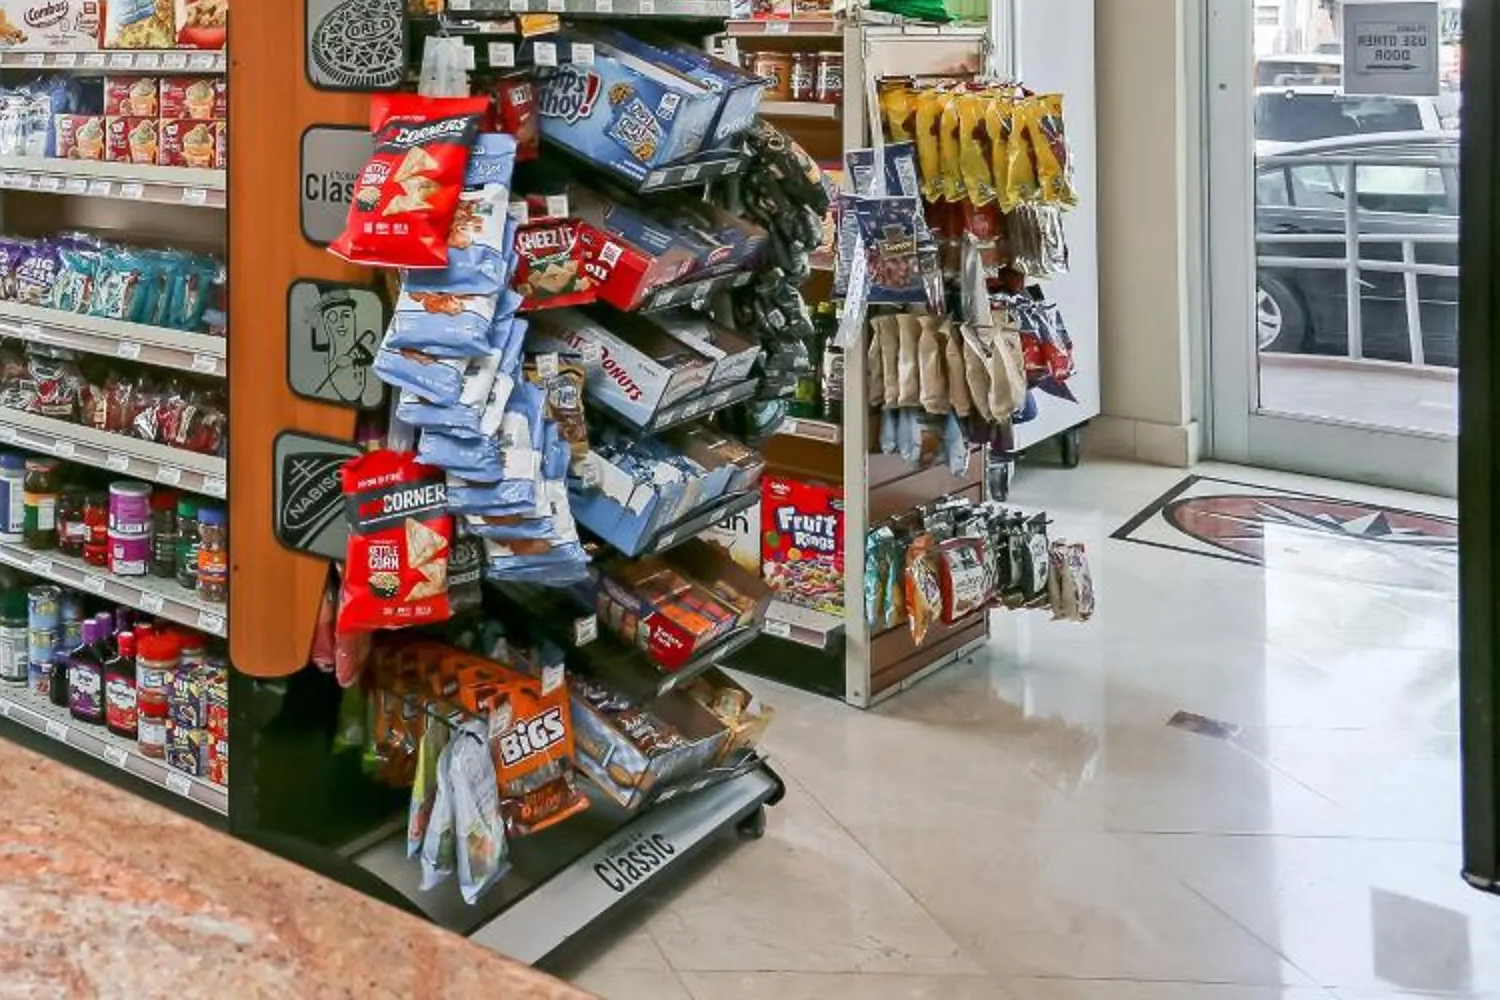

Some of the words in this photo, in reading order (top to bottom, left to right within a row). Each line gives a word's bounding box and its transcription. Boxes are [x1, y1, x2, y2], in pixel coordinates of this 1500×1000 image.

[305, 174, 354, 204] Clas
[289, 468, 344, 519] NABISC
[382, 483, 447, 513] CORNER
[777, 506, 837, 537] Fruit
[795, 531, 836, 551] Rings
[594, 833, 675, 892] Classic
